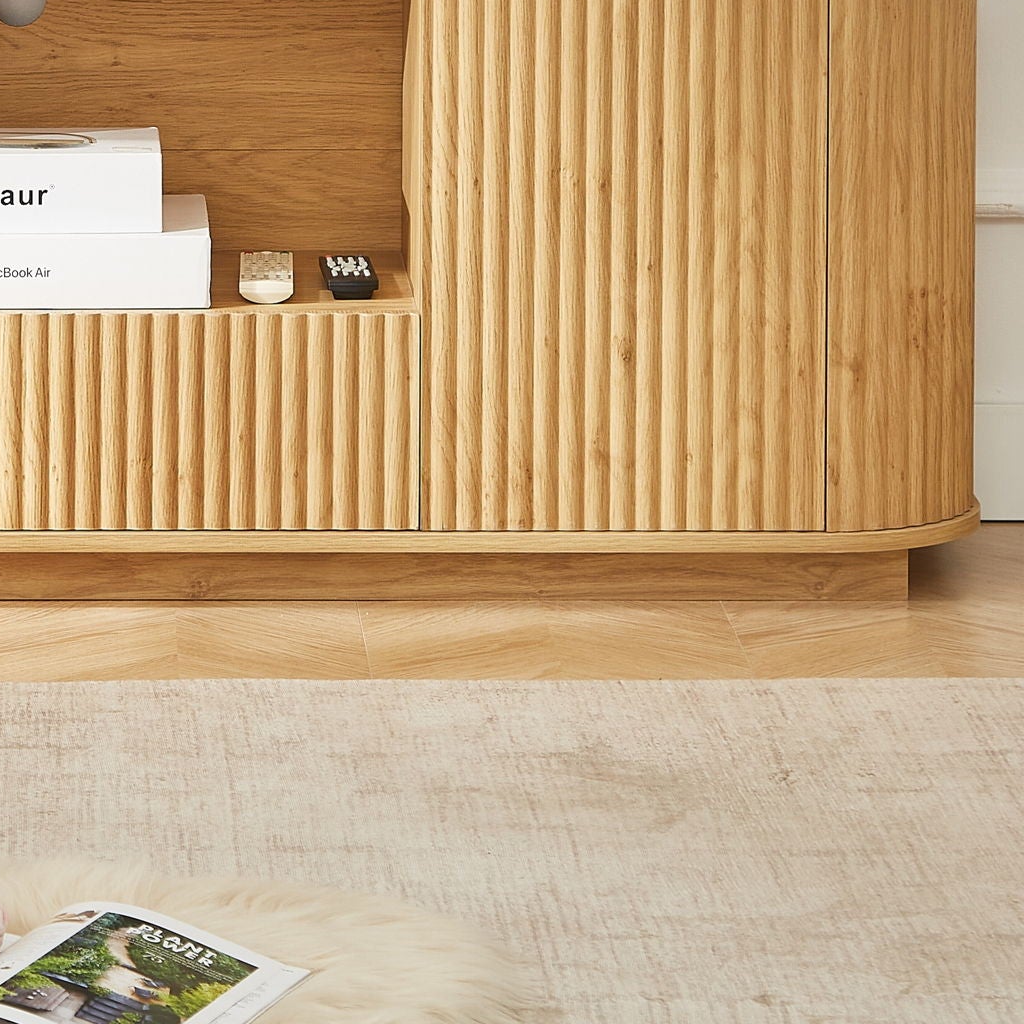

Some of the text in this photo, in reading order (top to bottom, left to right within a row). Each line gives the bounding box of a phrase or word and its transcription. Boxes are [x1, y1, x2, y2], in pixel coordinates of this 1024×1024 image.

[35, 266, 51, 278] Air
[127, 927, 214, 967] POWER
[139, 924, 218, 958] PLANT
